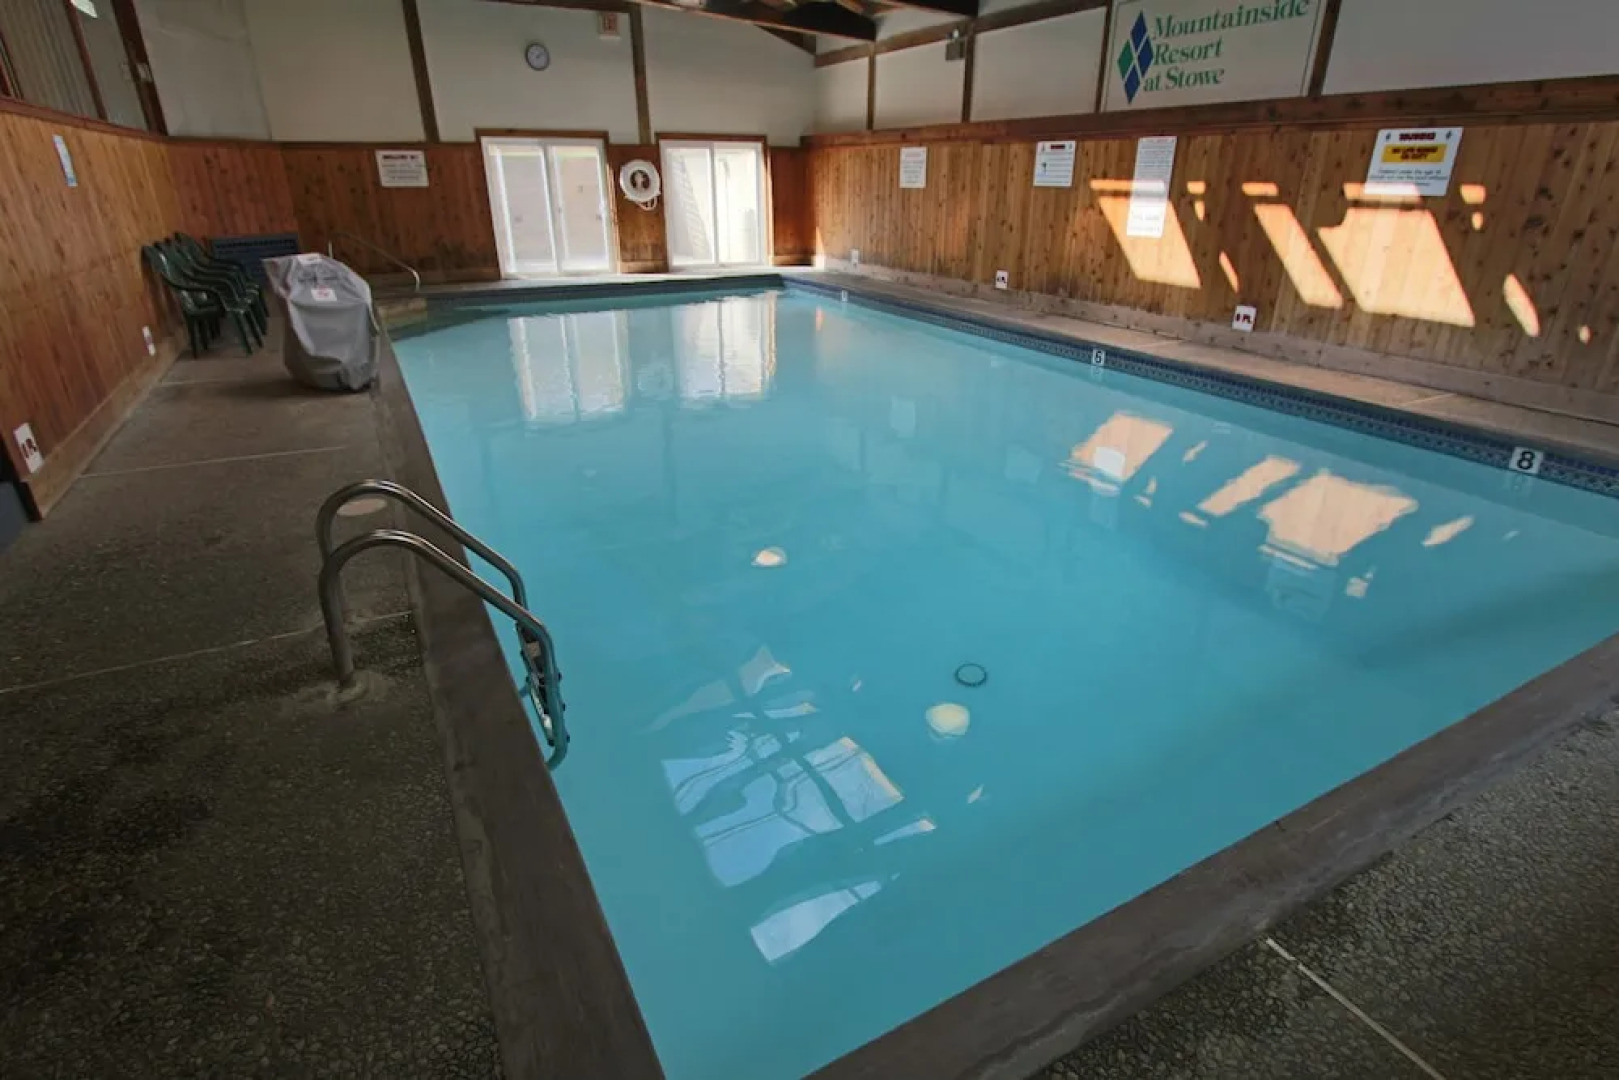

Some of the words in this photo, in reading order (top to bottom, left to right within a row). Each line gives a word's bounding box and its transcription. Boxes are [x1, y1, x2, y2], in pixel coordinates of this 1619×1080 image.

[1152, 0, 1309, 40] Mountainside
[1153, 37, 1223, 66] Resort
[1143, 73, 1162, 92] at
[1165, 66, 1225, 90] Stowe
[1516, 451, 1535, 470] 8
